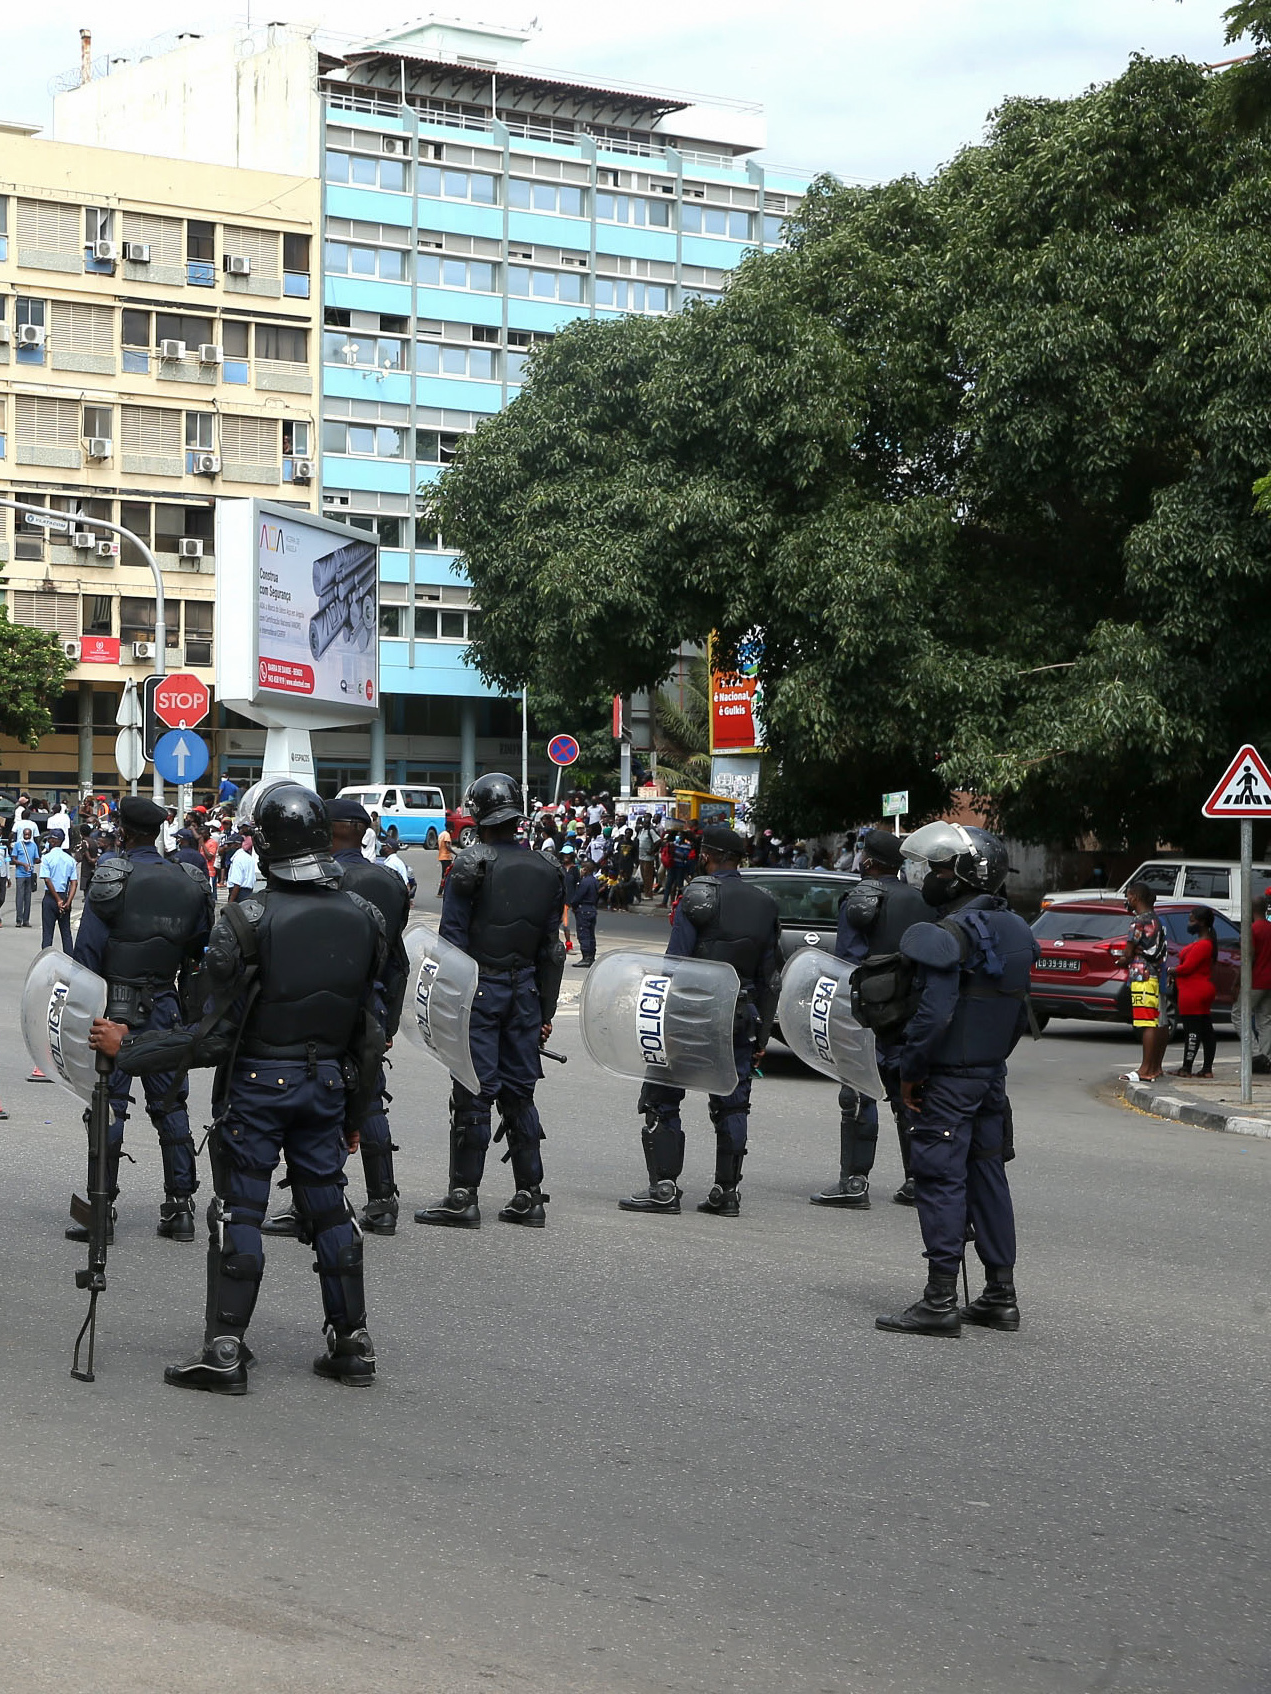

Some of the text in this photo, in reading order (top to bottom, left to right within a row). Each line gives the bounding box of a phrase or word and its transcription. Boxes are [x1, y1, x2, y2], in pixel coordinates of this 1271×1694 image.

[260, 567, 279, 583] Construa
[259, 585, 291, 603] com Segurança
[159, 692, 205, 709] STOP
[719, 690, 751, 701] Nacional,
[724, 704, 746, 715] Gulkis
[416, 963, 438, 1052] POLICA
[639, 980, 668, 1065] POLICIA
[813, 982, 836, 1064] POLICIA
